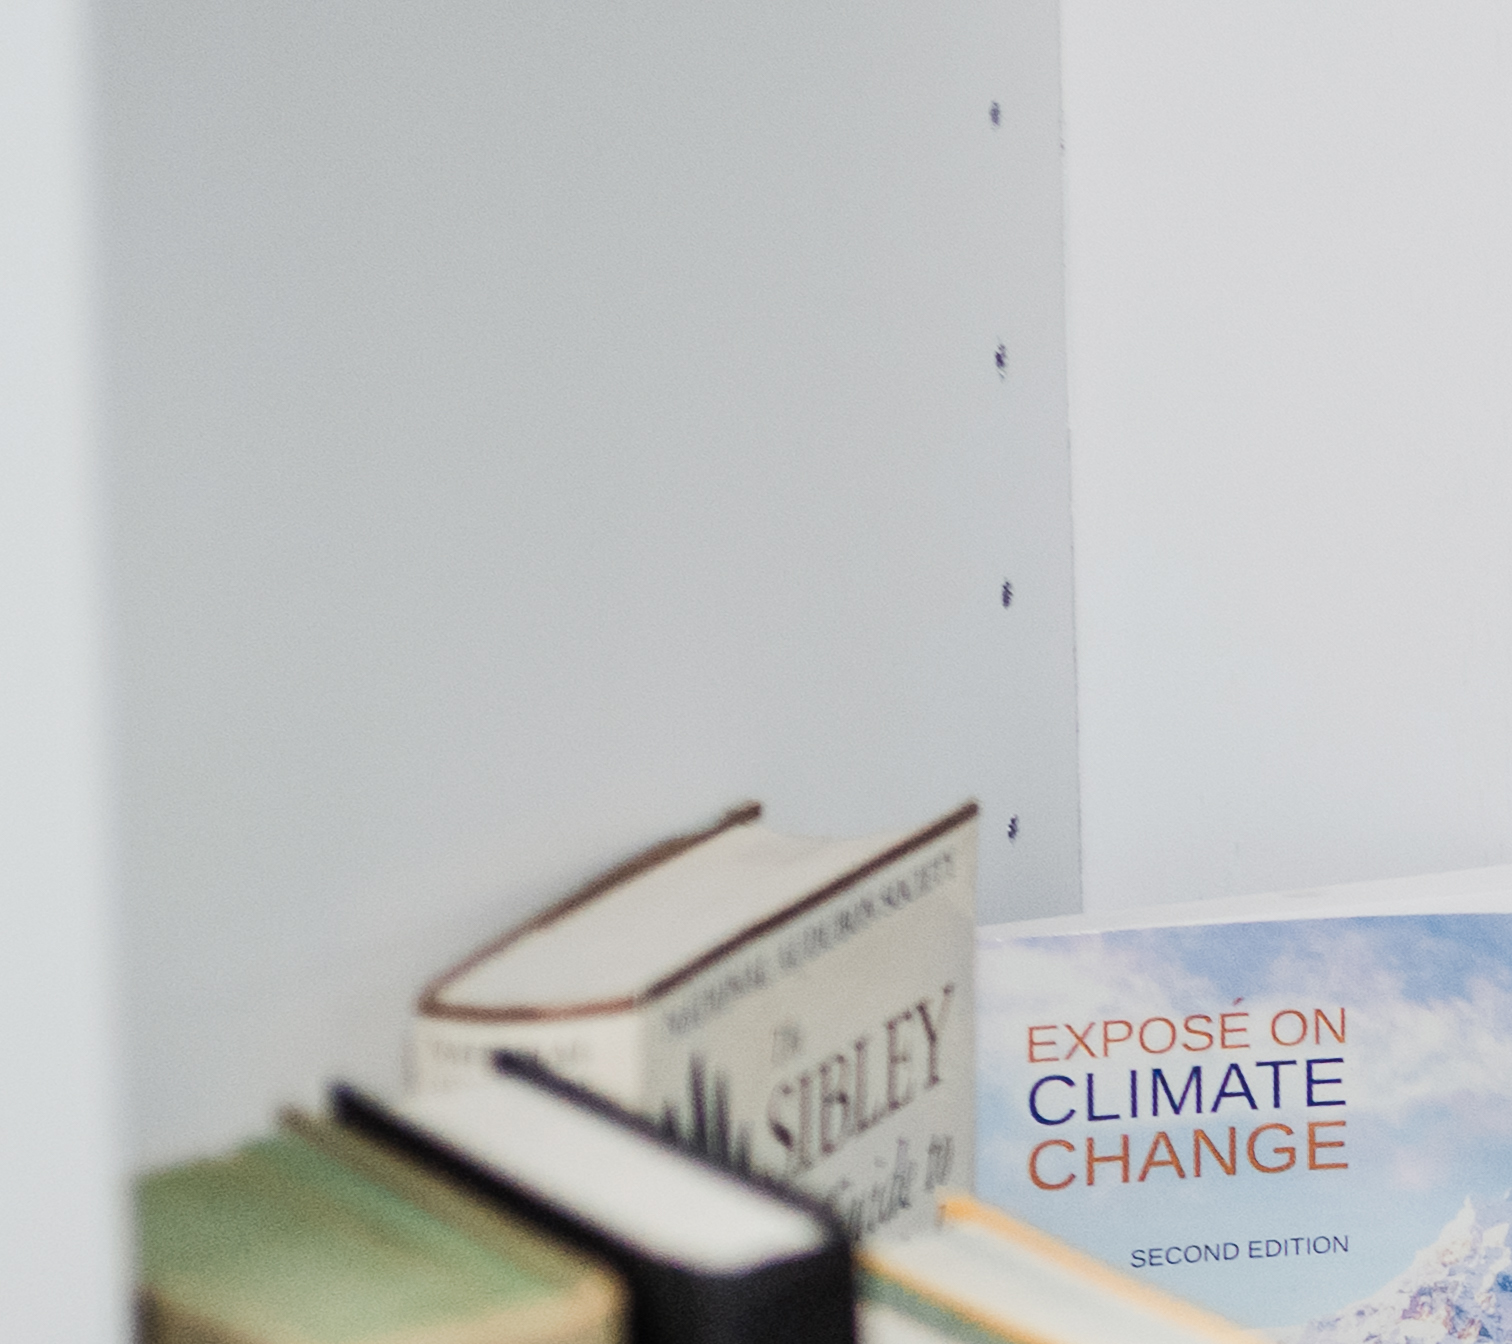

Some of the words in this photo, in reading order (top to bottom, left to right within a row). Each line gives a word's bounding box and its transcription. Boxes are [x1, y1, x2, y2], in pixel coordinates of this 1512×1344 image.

[1026, 998, 1249, 1063] EXPOSÉ
[1271, 1008, 1348, 1047] ON
[765, 982, 955, 1172] SIBLEY
[1027, 1058, 1348, 1127] CLIMATE
[1027, 1120, 1350, 1191] CHANGE
[1130, 1241, 1241, 1269] SECOND
[1248, 1235, 1350, 1260] EDITION
